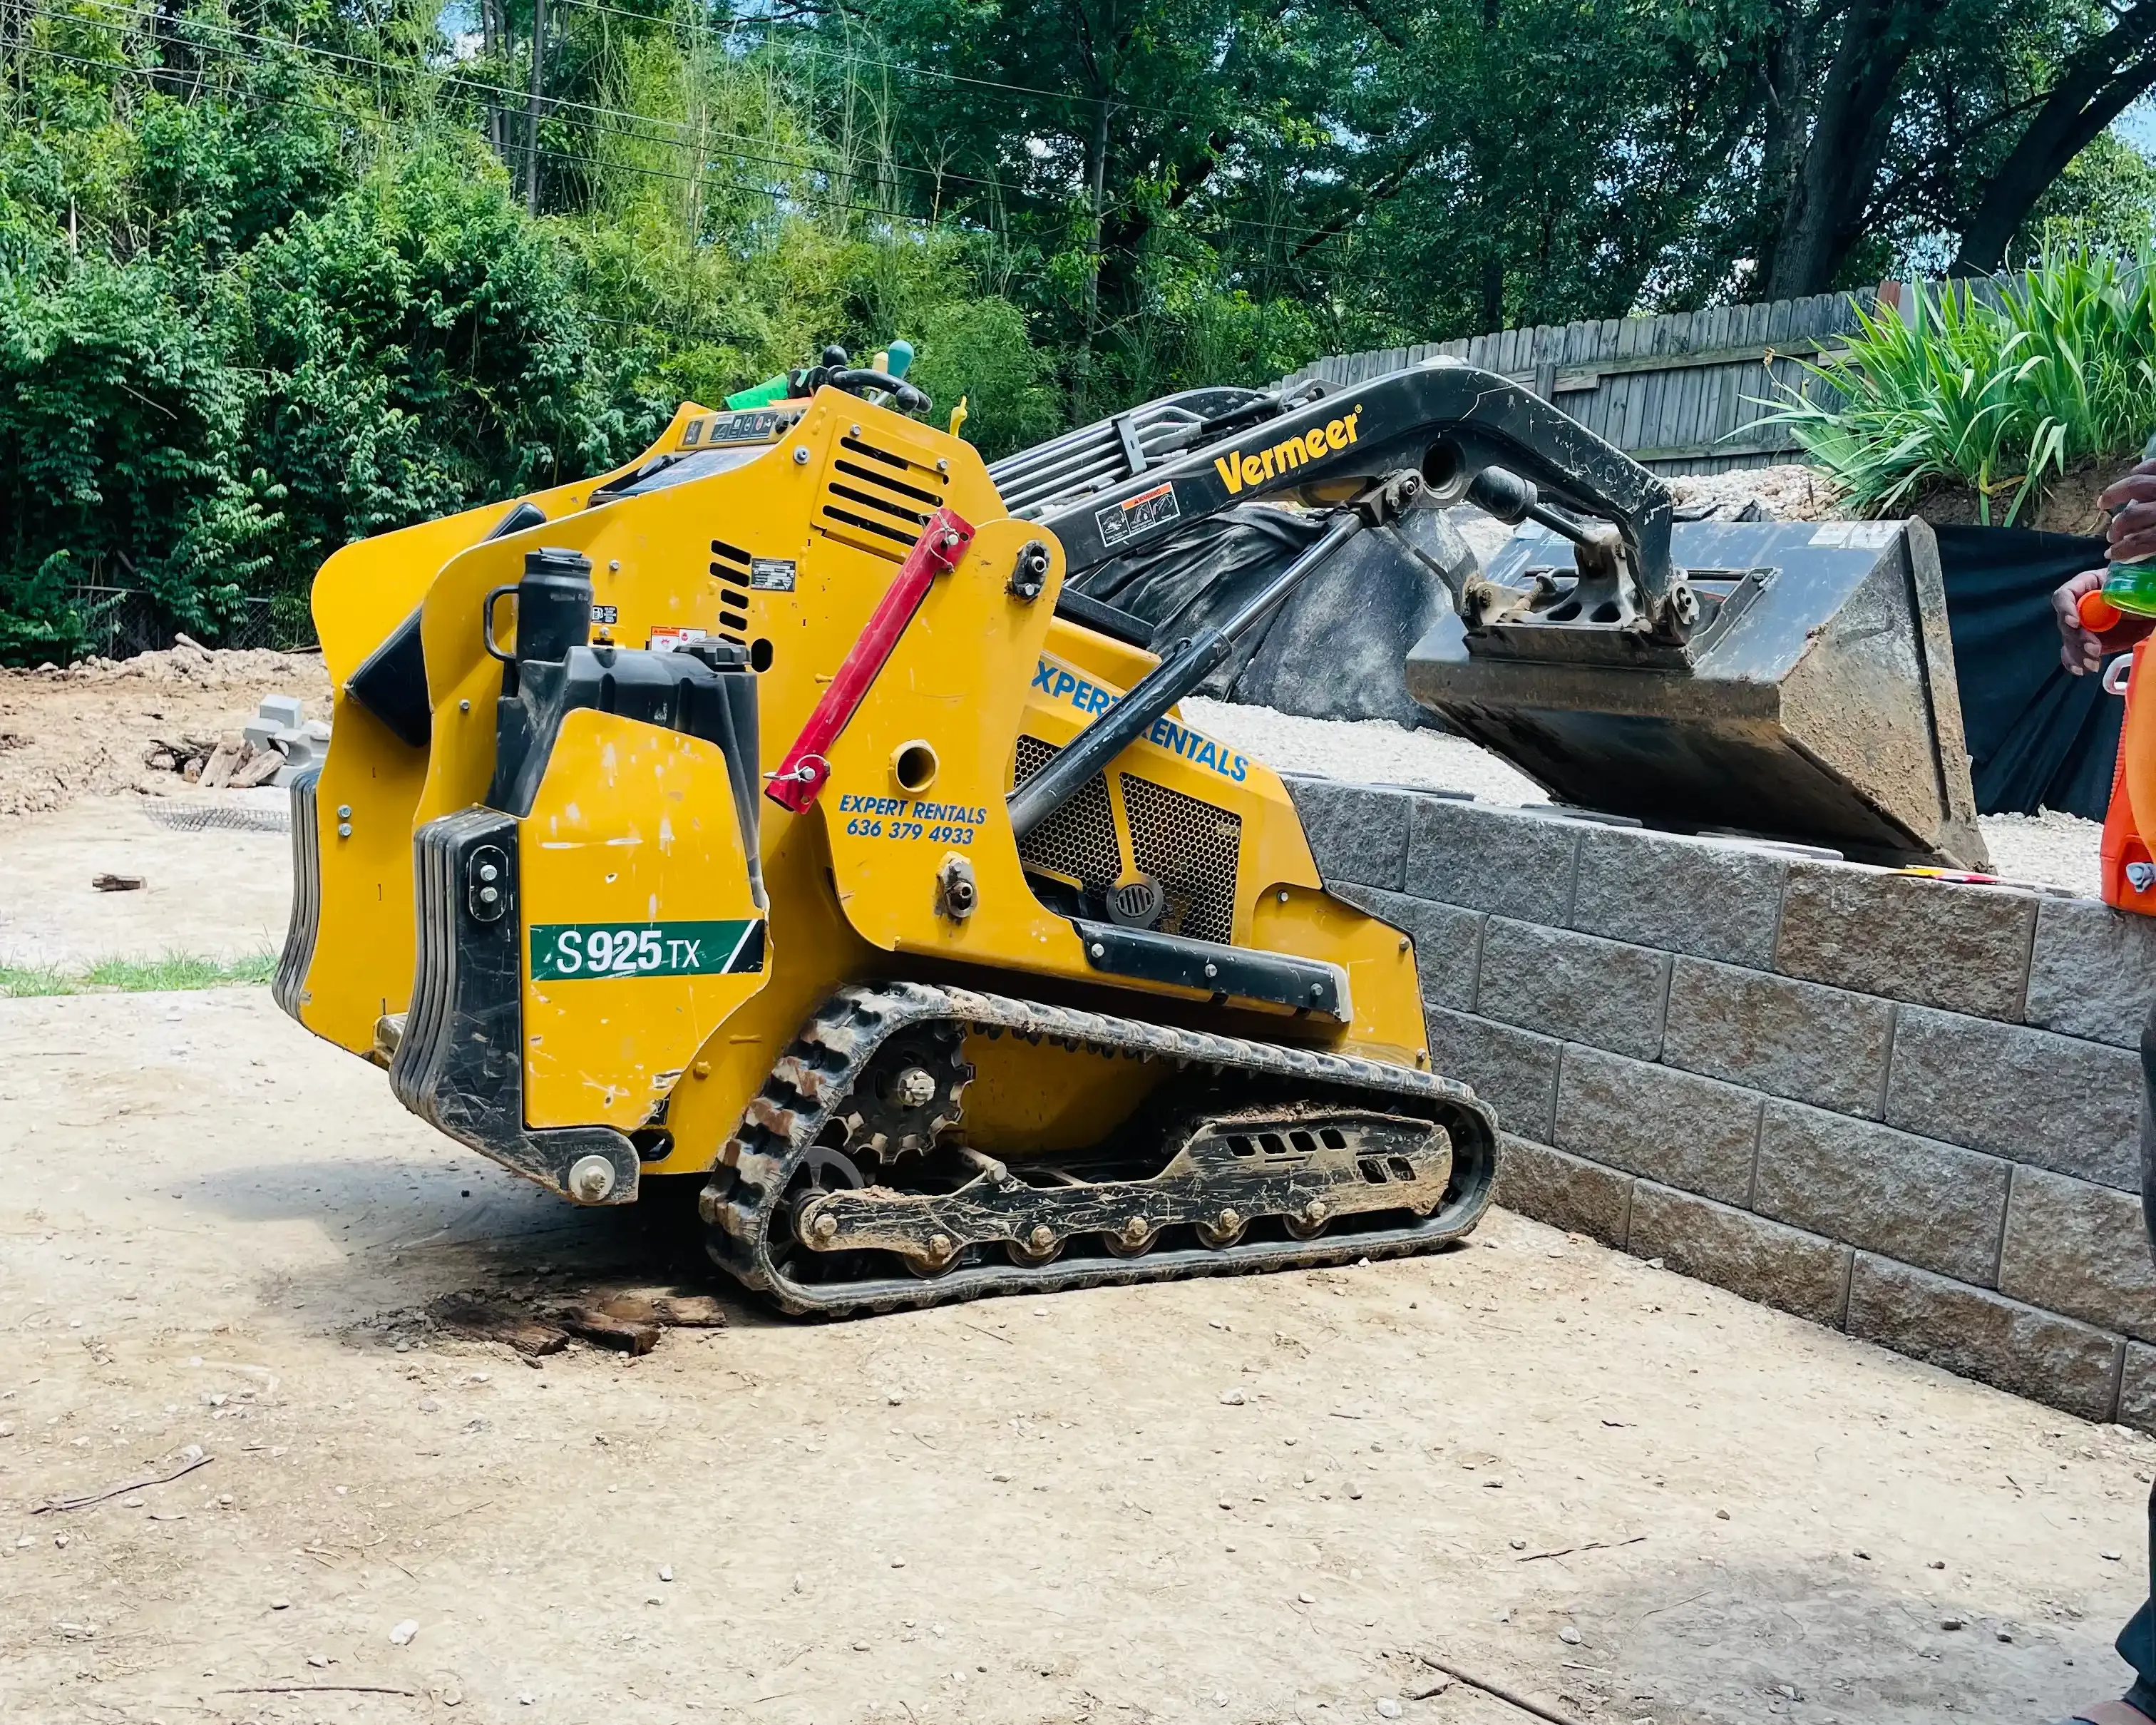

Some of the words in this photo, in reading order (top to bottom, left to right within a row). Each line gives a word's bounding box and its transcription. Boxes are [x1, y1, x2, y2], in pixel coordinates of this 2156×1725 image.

[1031, 660, 1122, 717] XPER
[1142, 716, 1248, 782] ENTALS
[839, 794, 909, 817] EXPERT
[912, 801, 987, 824] RENTALS
[847, 819, 882, 836] 636
[888, 821, 923, 840] 379
[928, 826, 974, 844] 4933
